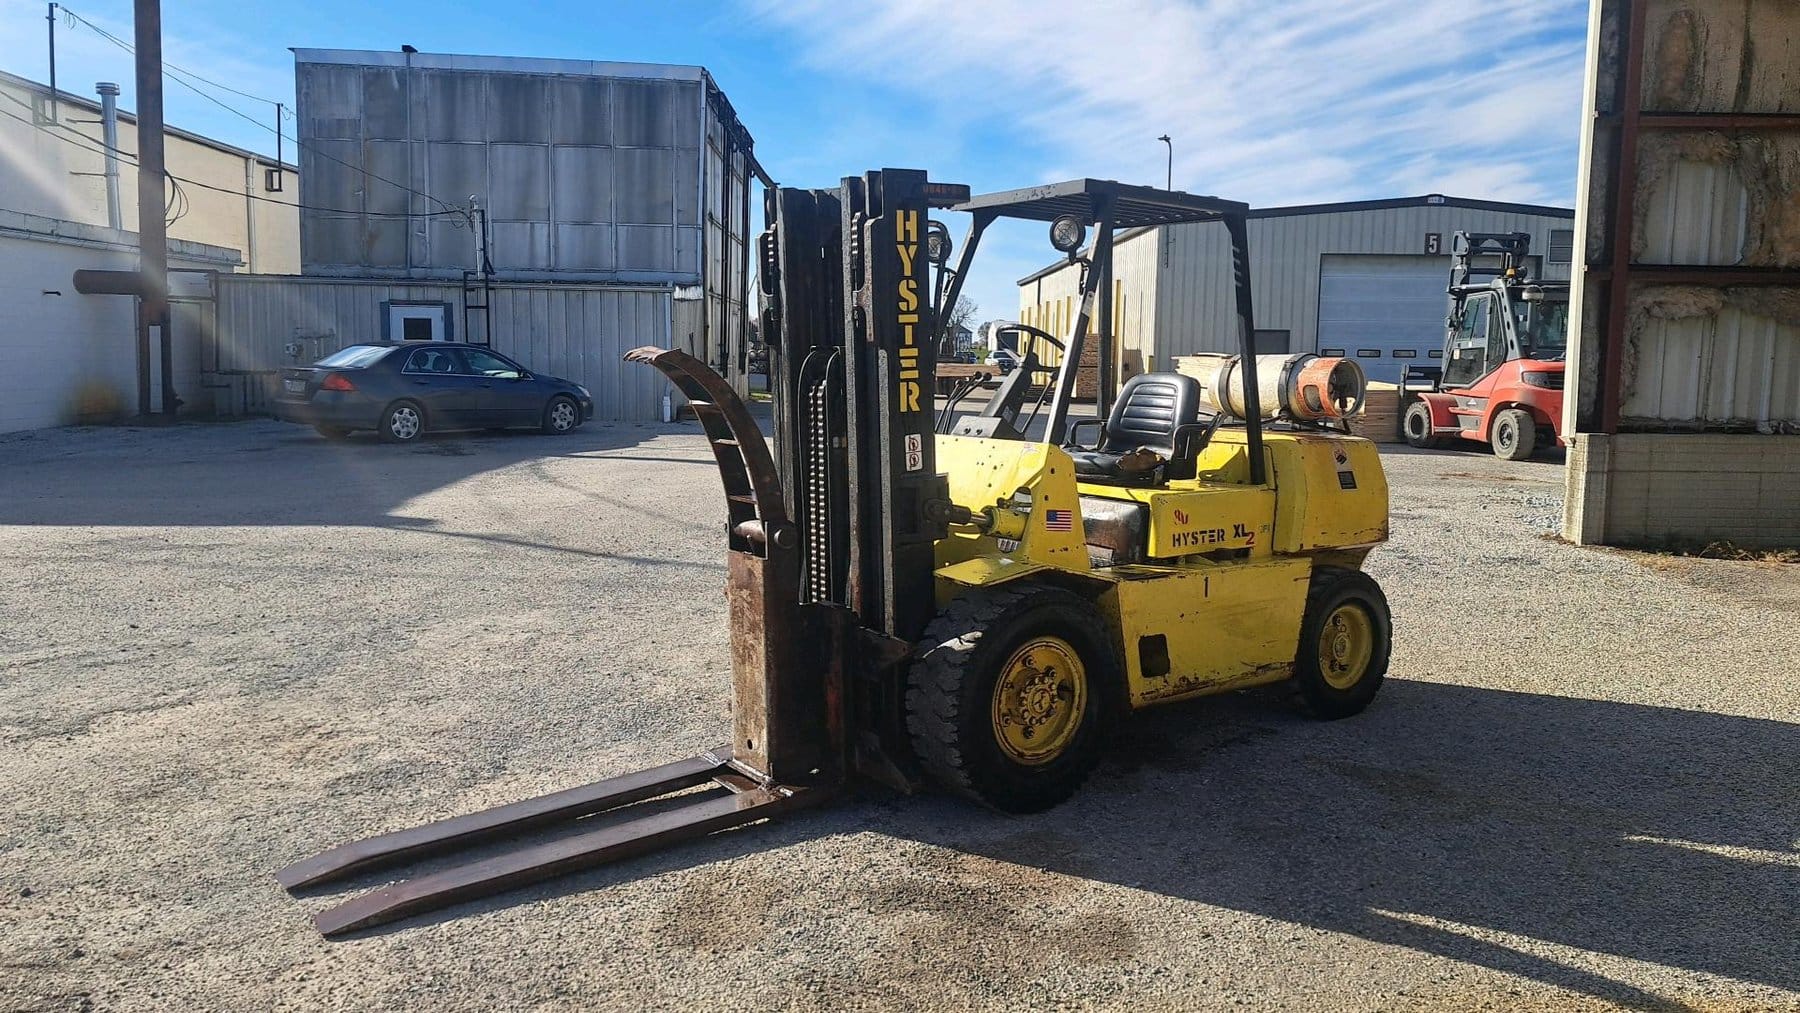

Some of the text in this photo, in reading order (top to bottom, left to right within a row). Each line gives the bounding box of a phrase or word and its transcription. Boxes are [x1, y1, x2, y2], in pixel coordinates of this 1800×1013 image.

[1428, 235, 1438, 253] 5
[896, 209, 921, 412] HYSTER
[1172, 528, 1225, 547] HYSTER
